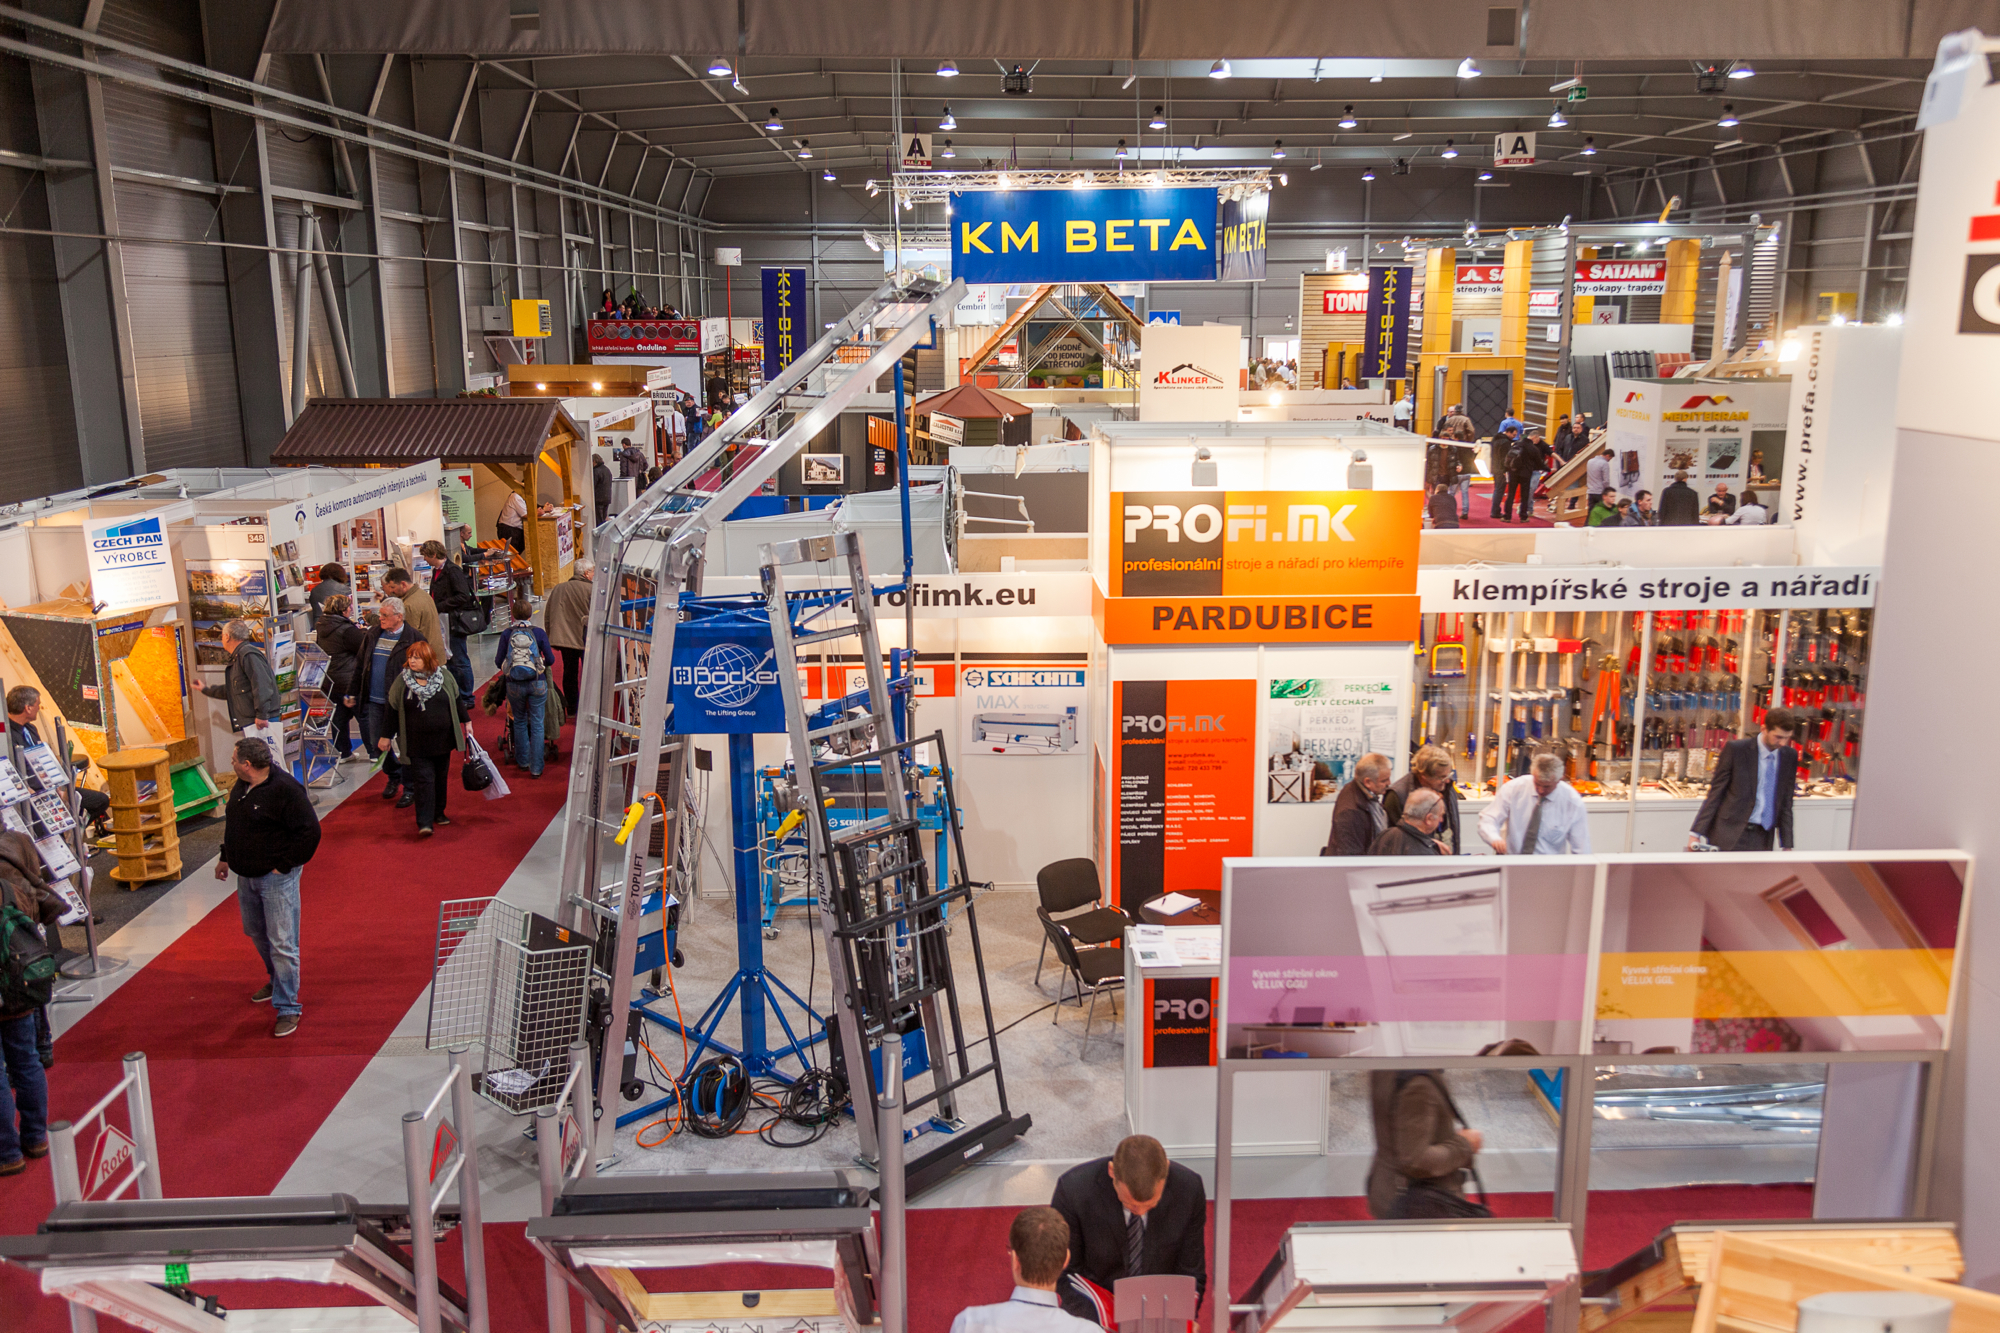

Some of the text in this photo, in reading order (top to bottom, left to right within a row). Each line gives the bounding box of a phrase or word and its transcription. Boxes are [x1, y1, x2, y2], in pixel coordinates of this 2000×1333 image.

[907, 138, 925, 157] A
[1510, 136, 1528, 155] A
[961, 218, 1207, 254] KM BETA
[1224, 219, 1266, 256] KM BETA
[778, 273, 791, 306] KM
[957, 303, 986, 311] Cembrit
[1377, 270, 1397, 375] KM BETA
[636, 343, 667, 351] Onduline
[1043, 359, 1085, 368] STŘECHOU
[652, 391, 676, 399] BŘIDLICE
[1616, 408, 1650, 422] MEDITERRAN
[1662, 411, 1749, 423] MEDITERRAN
[315, 501, 332, 518] Česká
[332, 497, 351, 512] komora
[353, 485, 387, 505] autorizovaných
[409, 471, 427, 486] techniků
[93, 534, 162, 549] CZECH PAN
[249, 534, 263, 542] 348
[103, 550, 158, 564] VÝROBCE
[1124, 557, 1404, 573] profesionální stroje a nářadí pro klempíře
[1453, 574, 1869, 605] klempířské stroje a nářadí
[1152, 604, 1373, 631] PARDUBICE
[694, 666, 780, 685] Böcker
[989, 671, 1083, 686] SCHECHTL
[977, 695, 1019, 709] MAX
[1330, 698, 1374, 706] ČECHÁCH
[1310, 716, 1348, 725] PERKEO
[1122, 738, 1166, 746] profesionální
[631, 853, 643, 897] TOPLIFT
[816, 870, 830, 915] TOPLIFT
[1252, 969, 1338, 979] Kyvné střešní okno
[1622, 965, 1707, 975] Kyvné střešní okno
[1252, 980, 1284, 989] VELUX
[1621, 976, 1652, 985] VELUX
[1154, 1026, 1209, 1036] profesionální
[101, 1144, 129, 1180] Roto
